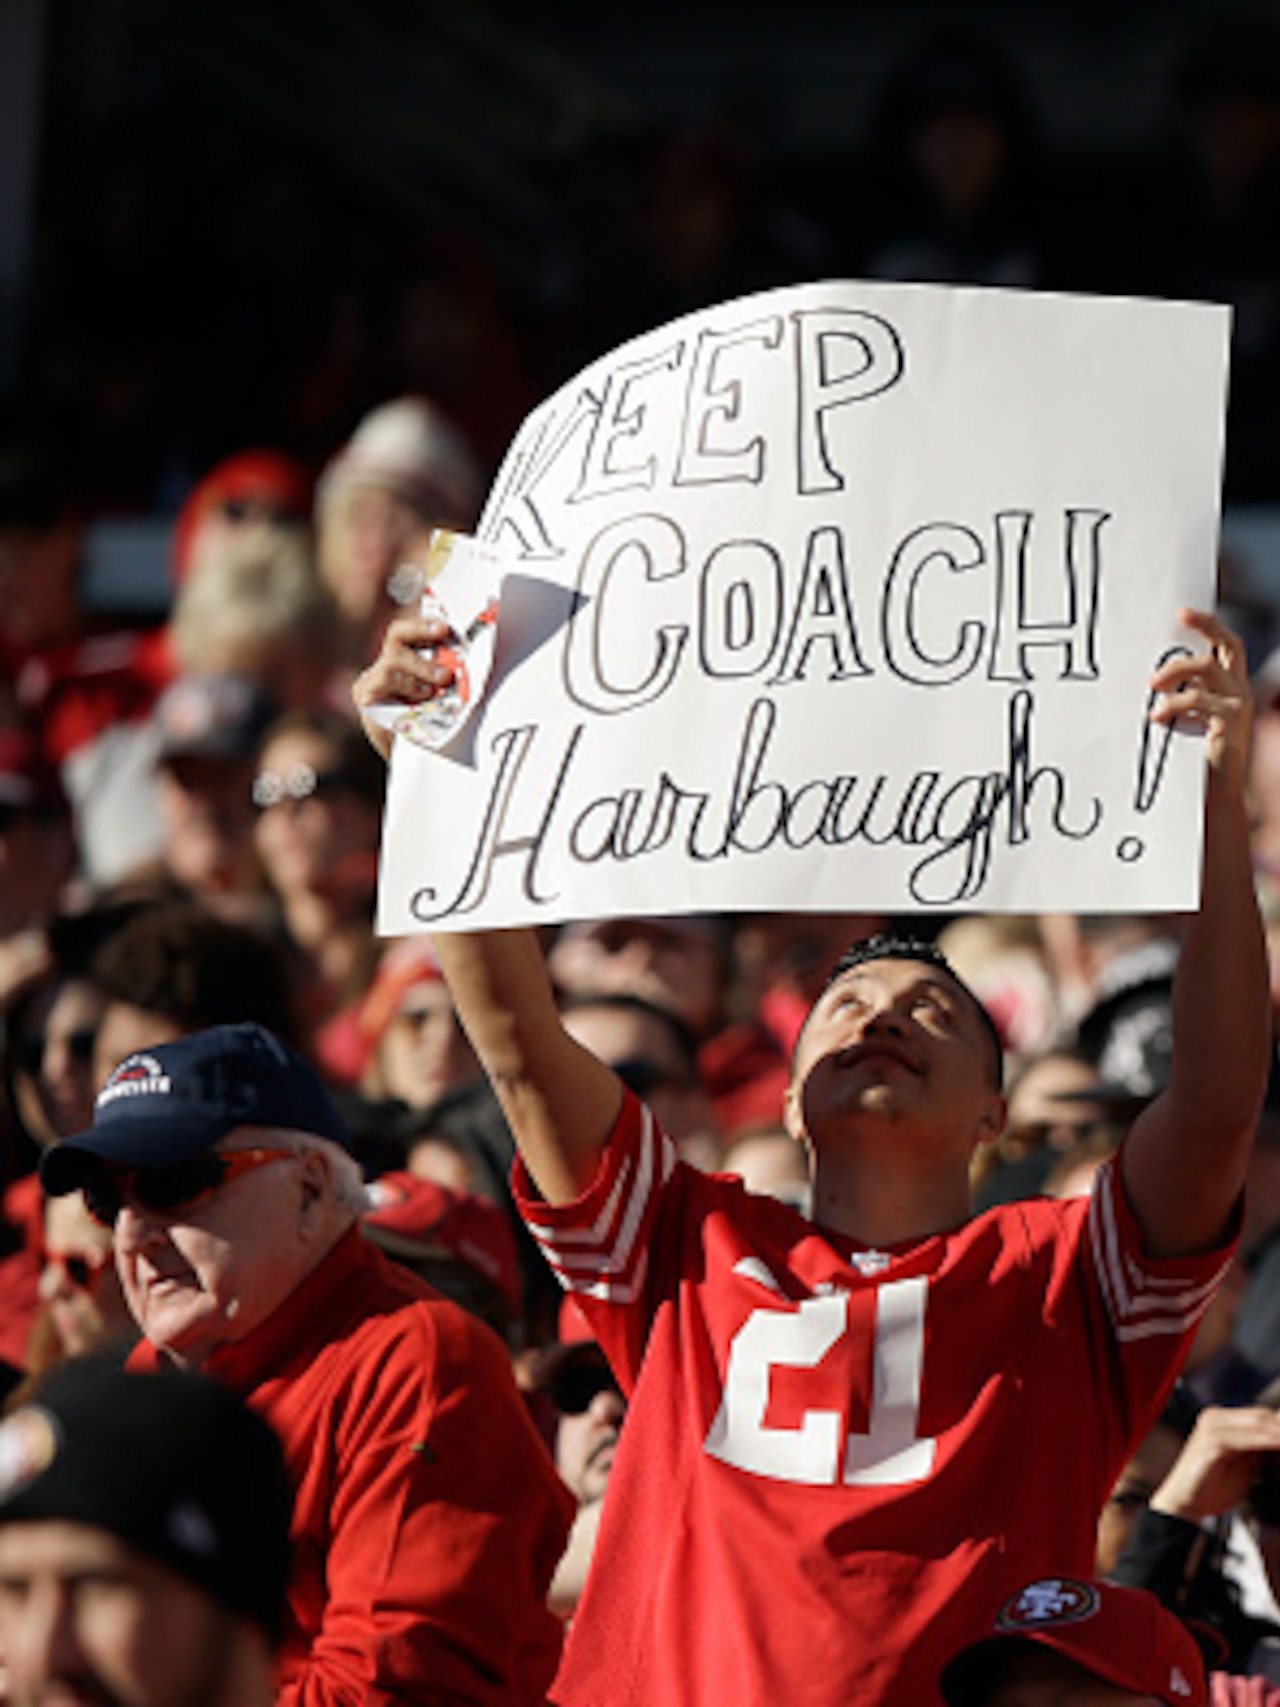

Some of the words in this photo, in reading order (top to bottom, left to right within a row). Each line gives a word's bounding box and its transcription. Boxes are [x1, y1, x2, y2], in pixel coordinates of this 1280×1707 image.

[480, 307, 904, 562] KEEP
[560, 508, 1112, 716] COACH
[702, 1275, 937, 1487] 21
